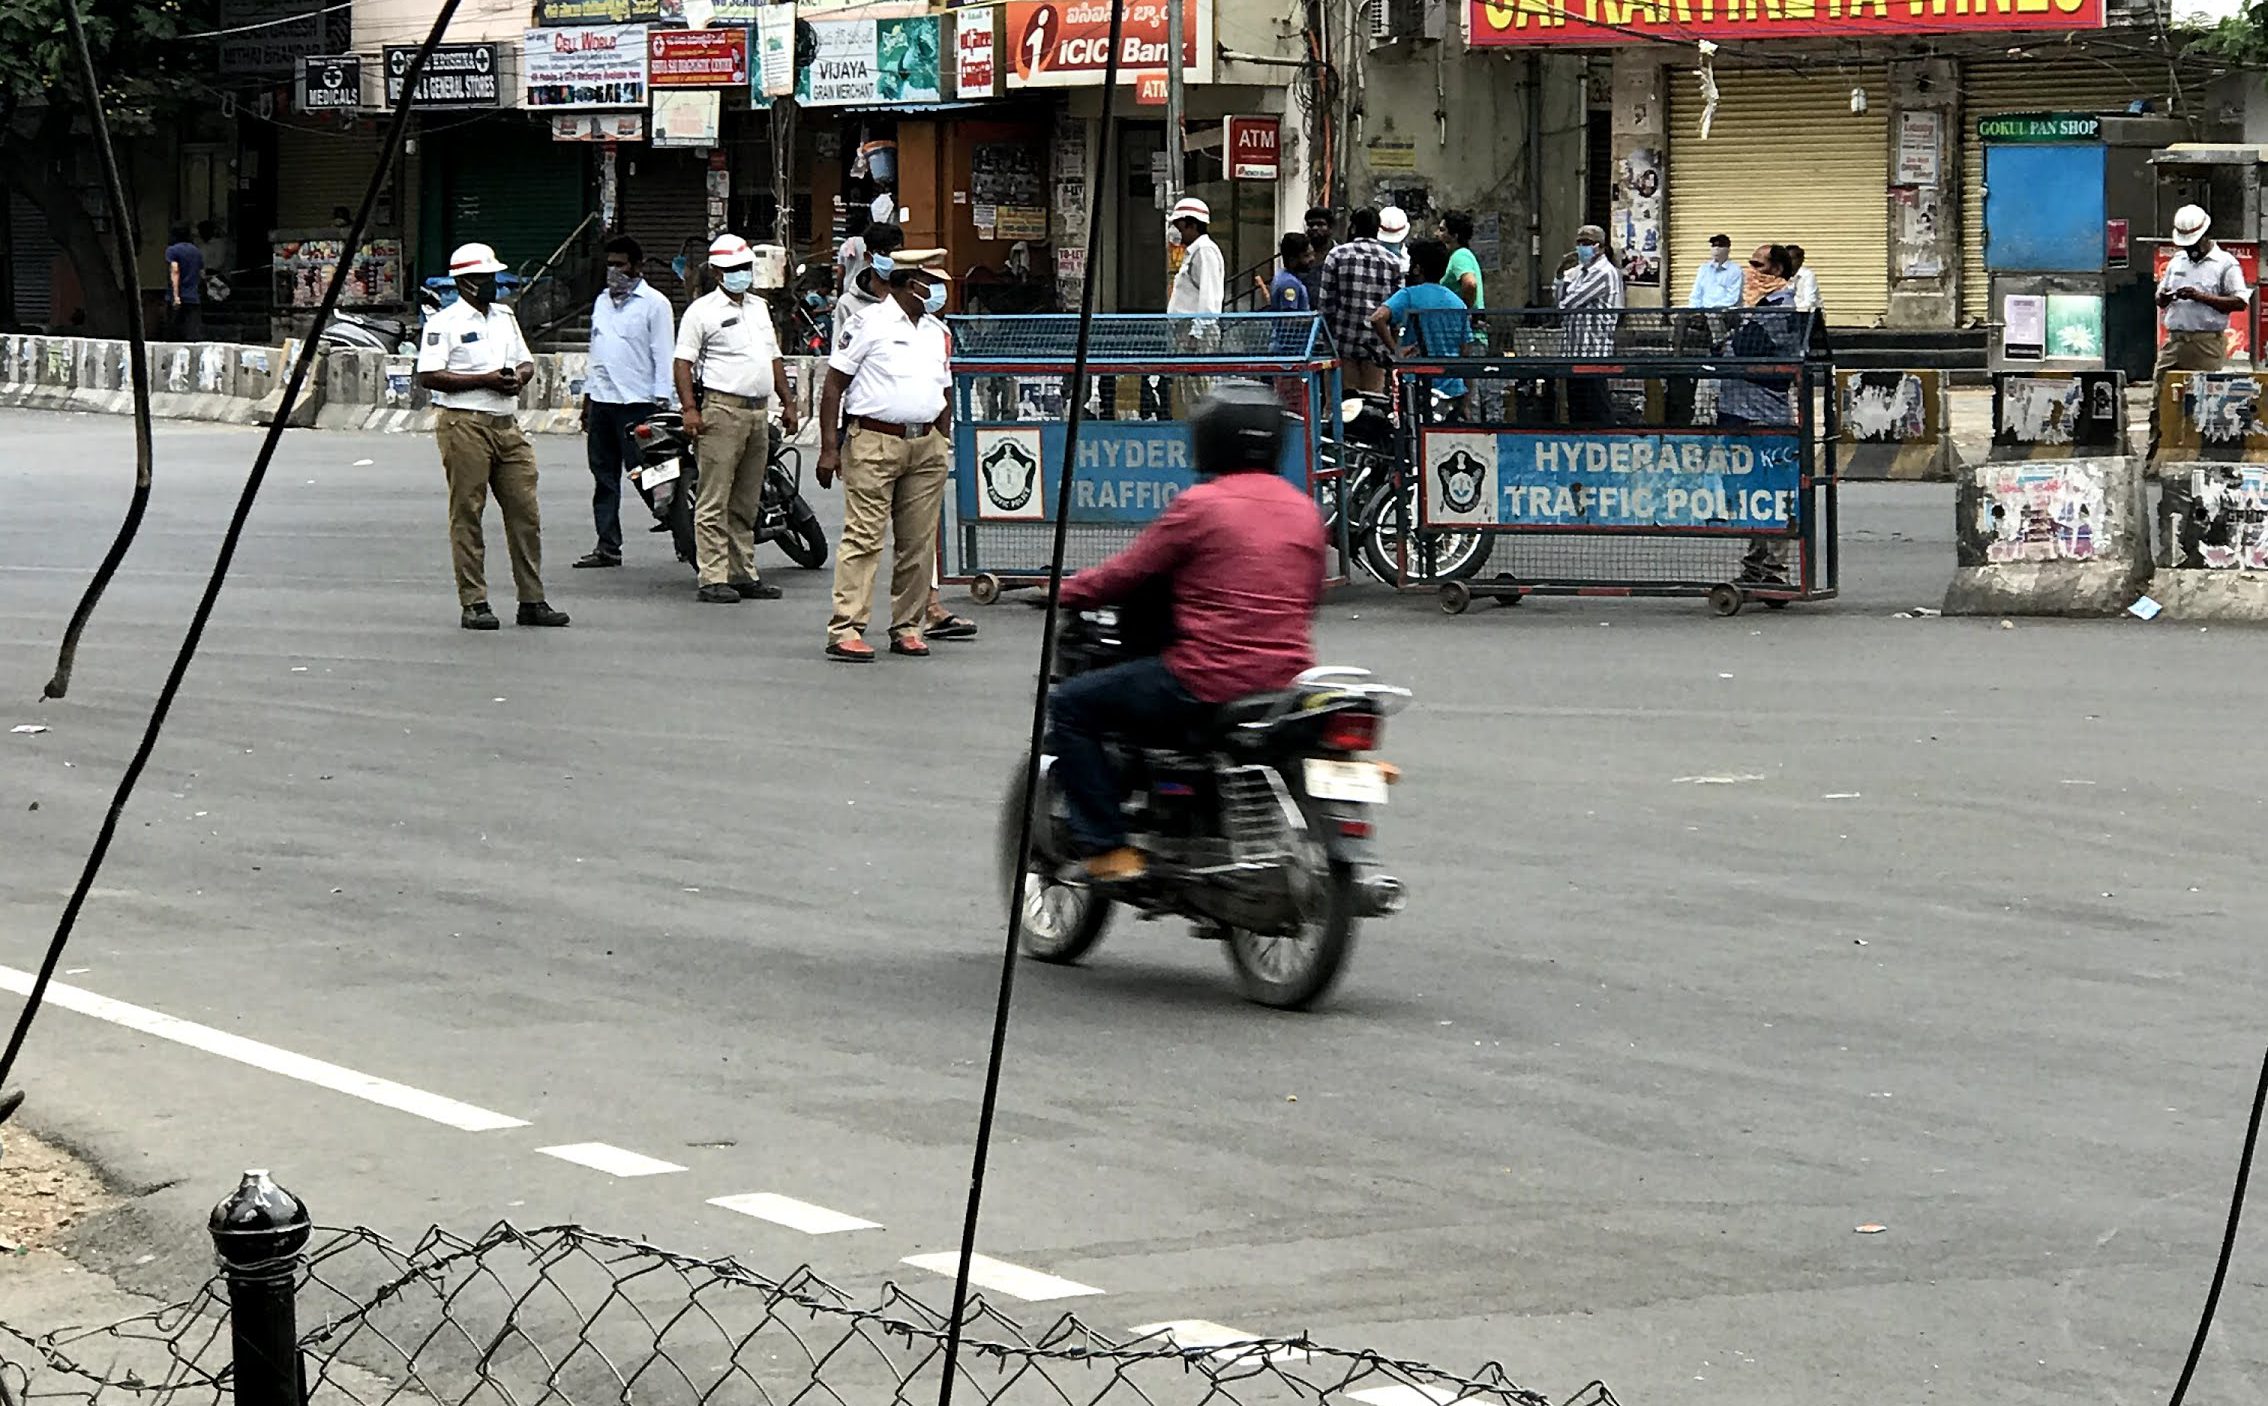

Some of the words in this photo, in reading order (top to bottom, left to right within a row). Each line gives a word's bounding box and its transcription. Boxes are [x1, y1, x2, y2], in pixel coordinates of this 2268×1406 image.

[819, 60, 868, 80] VIJAYA
[309, 88, 358, 105] MEDICALS
[465, 74, 495, 98] STORES
[813, 83, 834, 100] GRAIN
[1238, 129, 1275, 148] ATM
[1980, 121, 2028, 136] GOKUL
[2030, 121, 2058, 135] PAN
[2060, 120, 2099, 135] SHOP
[1079, 440, 1188, 468] HYDER
[1535, 441, 1754, 475] HYDERABAD
[1058, 480, 1181, 509] RAFFIC
[1503, 485, 1656, 519] TRAFFIC
[1667, 488, 1796, 521] POLICE
